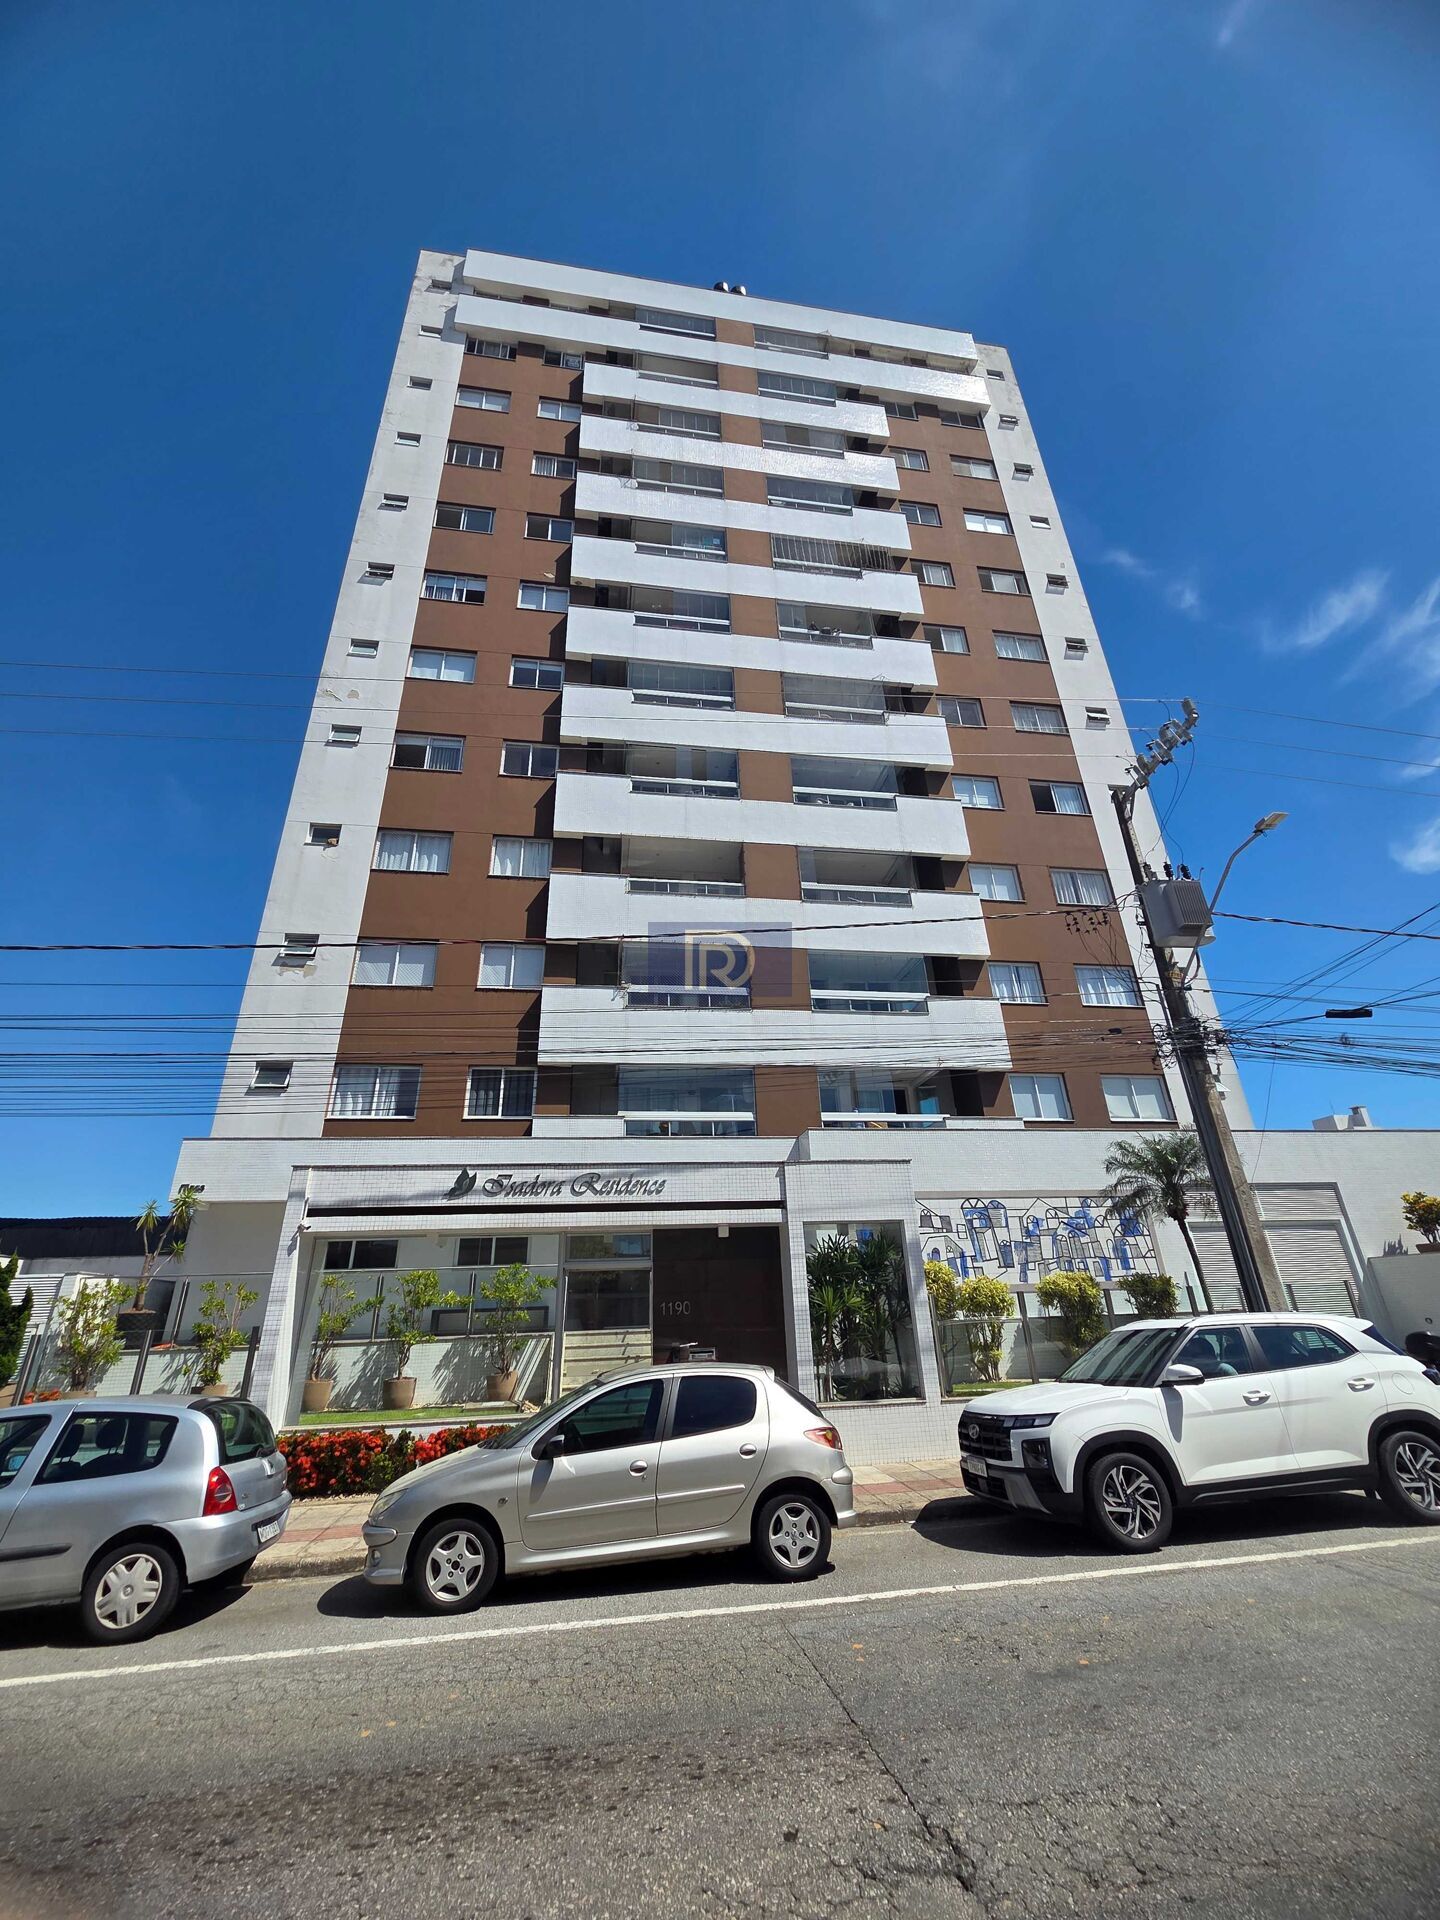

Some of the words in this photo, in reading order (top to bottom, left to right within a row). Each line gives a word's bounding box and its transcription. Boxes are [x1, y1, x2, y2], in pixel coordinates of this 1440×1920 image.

[482, 1174, 564, 1198] Isadora
[570, 1172, 667, 1197] Residence
[660, 1301, 691, 1316] 1190
